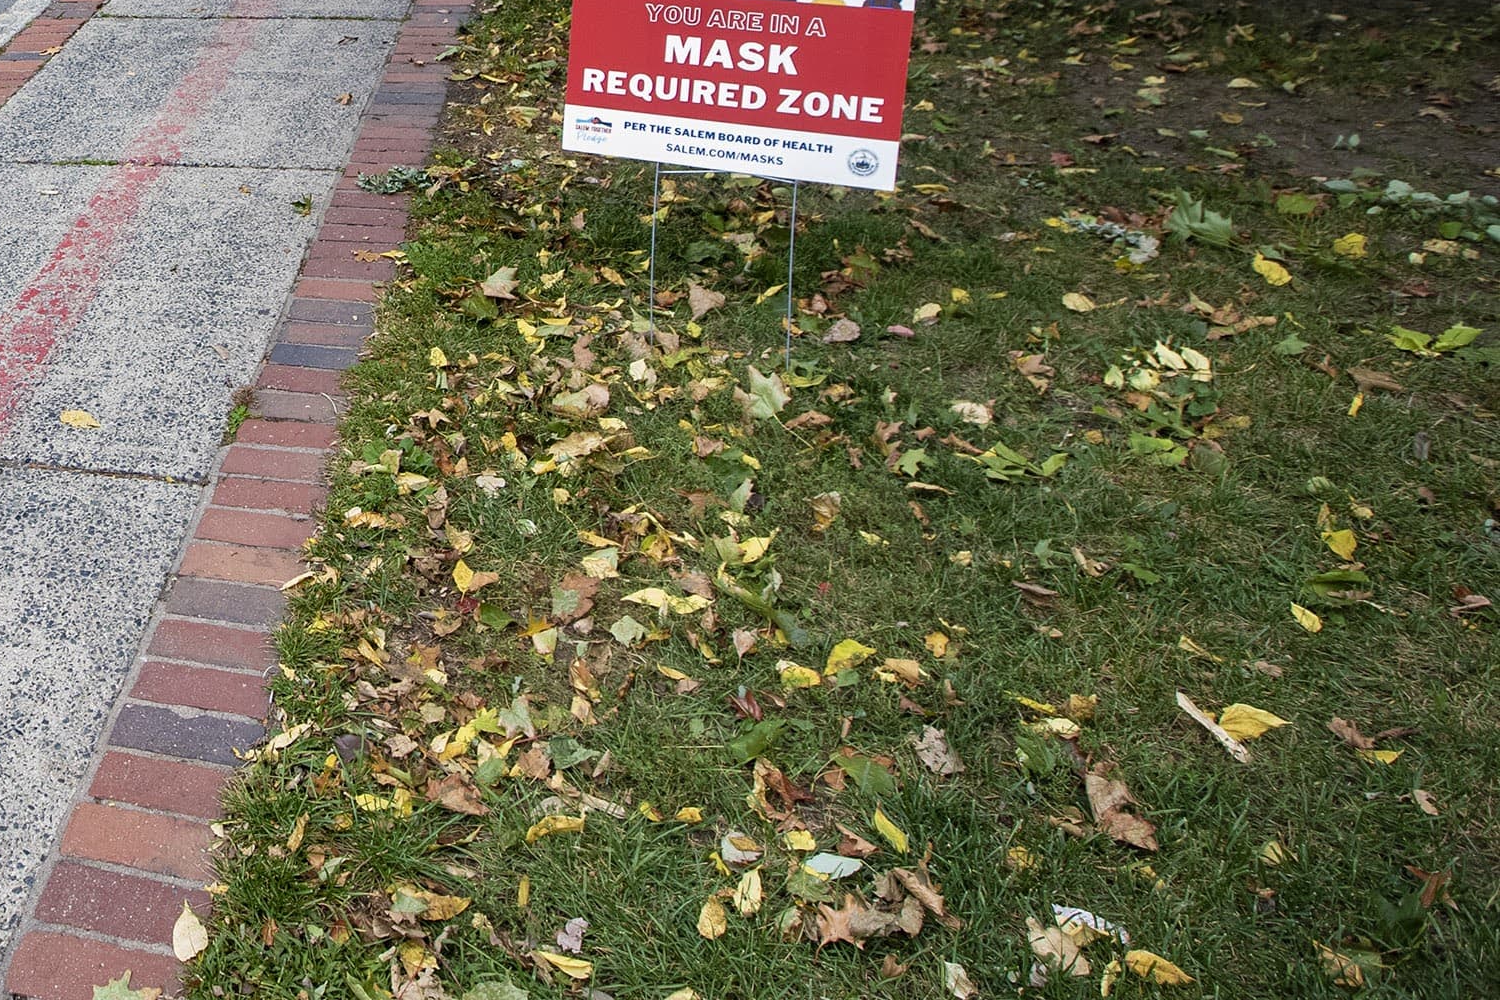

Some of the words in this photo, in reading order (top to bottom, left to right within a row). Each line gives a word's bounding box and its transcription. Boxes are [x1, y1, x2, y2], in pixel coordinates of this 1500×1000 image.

[645, 3, 702, 26] YOU
[706, 9, 764, 32] ARE
[769, 14, 800, 35] IN
[805, 18, 827, 37] A
[663, 34, 799, 76] MASK
[582, 68, 767, 110] REQUIRED
[775, 88, 886, 123] ZONE
[623, 121, 646, 132] PER
[649, 124, 672, 135] THE
[674, 127, 716, 140] SALEM
[718, 132, 761, 146] BOARD
[763, 138, 780, 147] OF
[782, 140, 833, 154] HEALTH
[665, 143, 784, 166] SALEM.COM/MASKS
